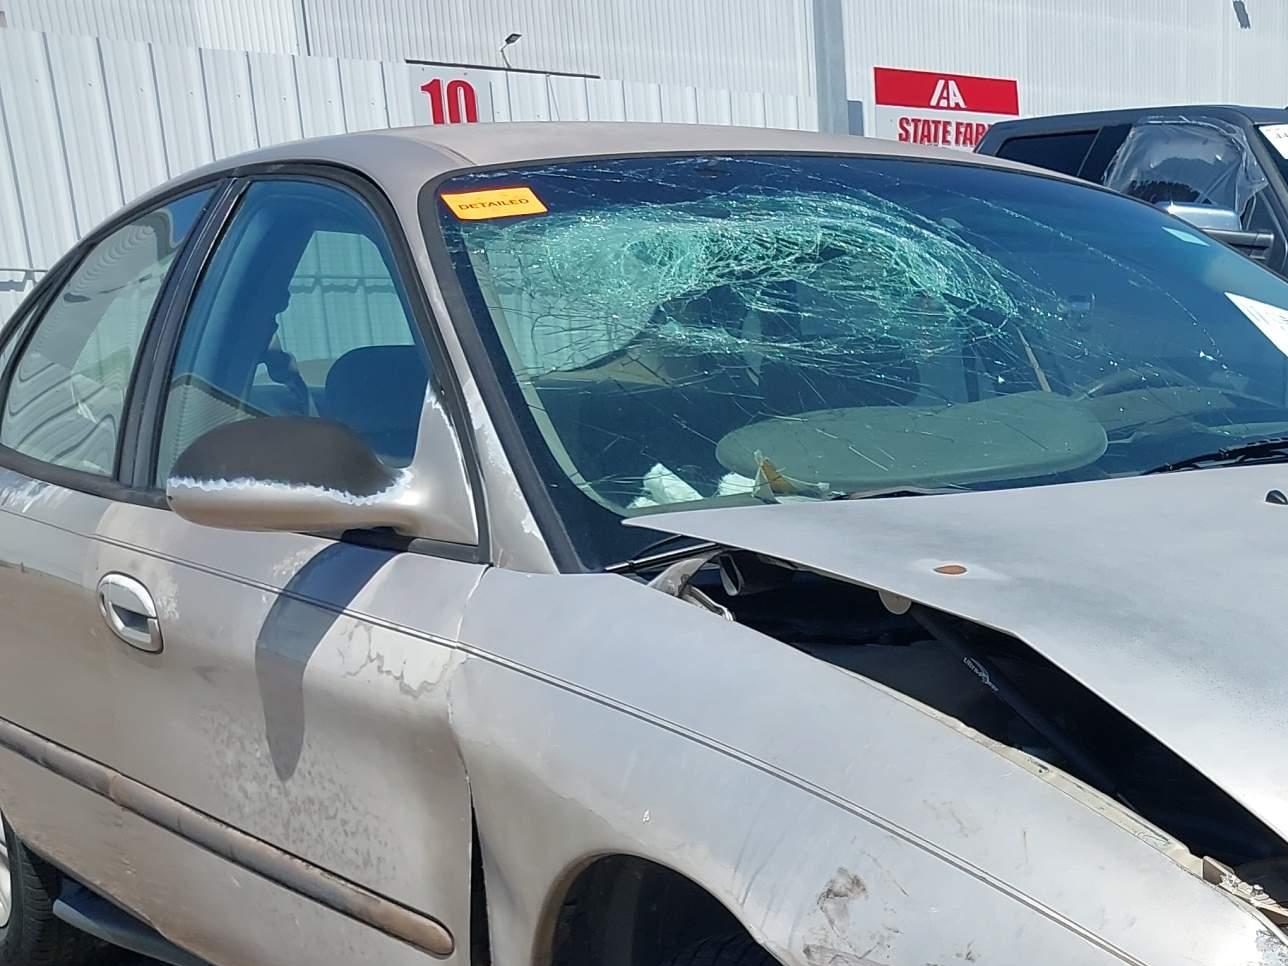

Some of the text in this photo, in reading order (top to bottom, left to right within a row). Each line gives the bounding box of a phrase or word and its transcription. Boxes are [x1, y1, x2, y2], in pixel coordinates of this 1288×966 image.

[419, 77, 478, 125] 10
[898, 117, 993, 147] STATE FAR
[458, 198, 529, 210] DETAILED
